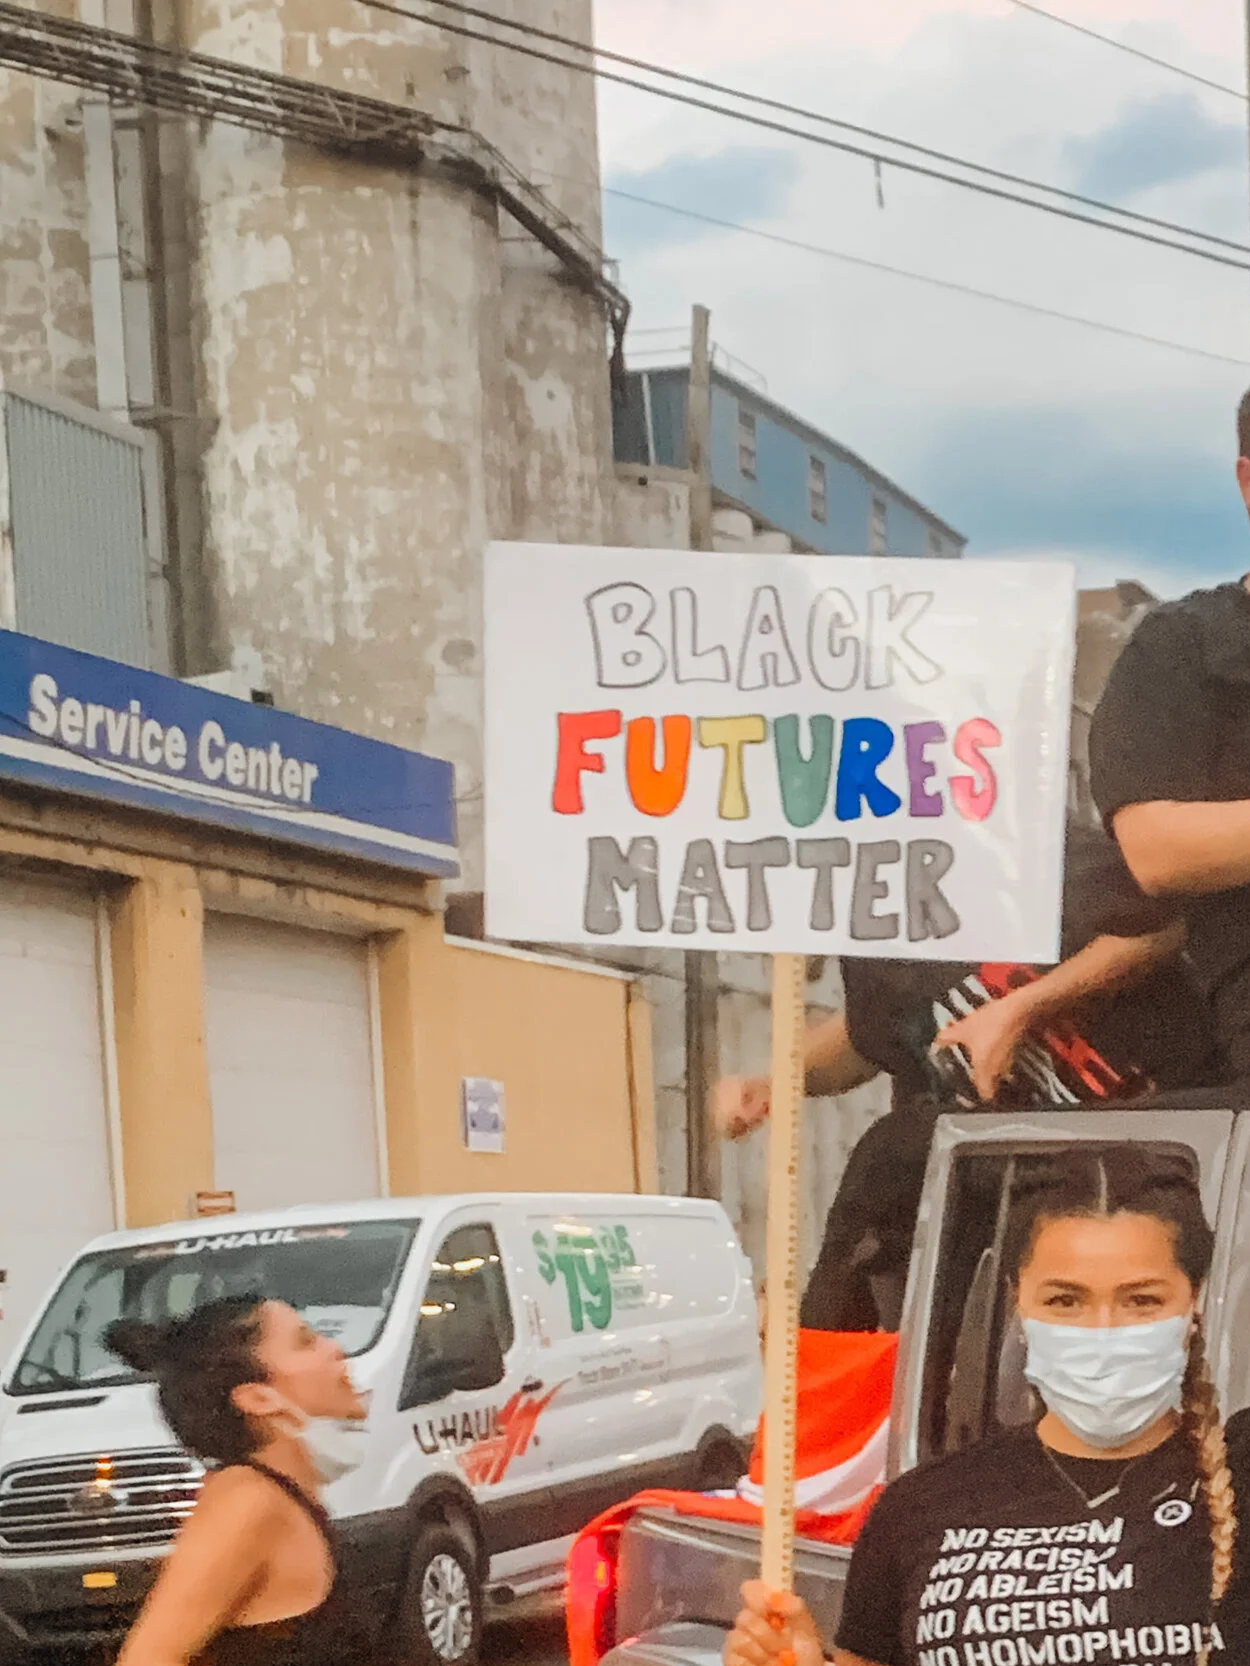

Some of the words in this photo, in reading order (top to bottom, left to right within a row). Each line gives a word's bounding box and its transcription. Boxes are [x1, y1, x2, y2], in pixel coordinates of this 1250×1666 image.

[584, 581, 945, 692] BLACK
[28, 673, 188, 771] Service
[199, 719, 319, 804] Center
[551, 709, 1002, 828] FUTURES
[583, 836, 961, 943] MATTER
[929, 1552, 977, 1579] NO
[939, 1527, 989, 1552] NO
[990, 1516, 1125, 1548] SEXISM
[916, 1608, 957, 1645] NO
[962, 1596, 1110, 1636] AGEISM
[920, 1577, 964, 1610] NO
[965, 1562, 1135, 1600] ABLEISM
